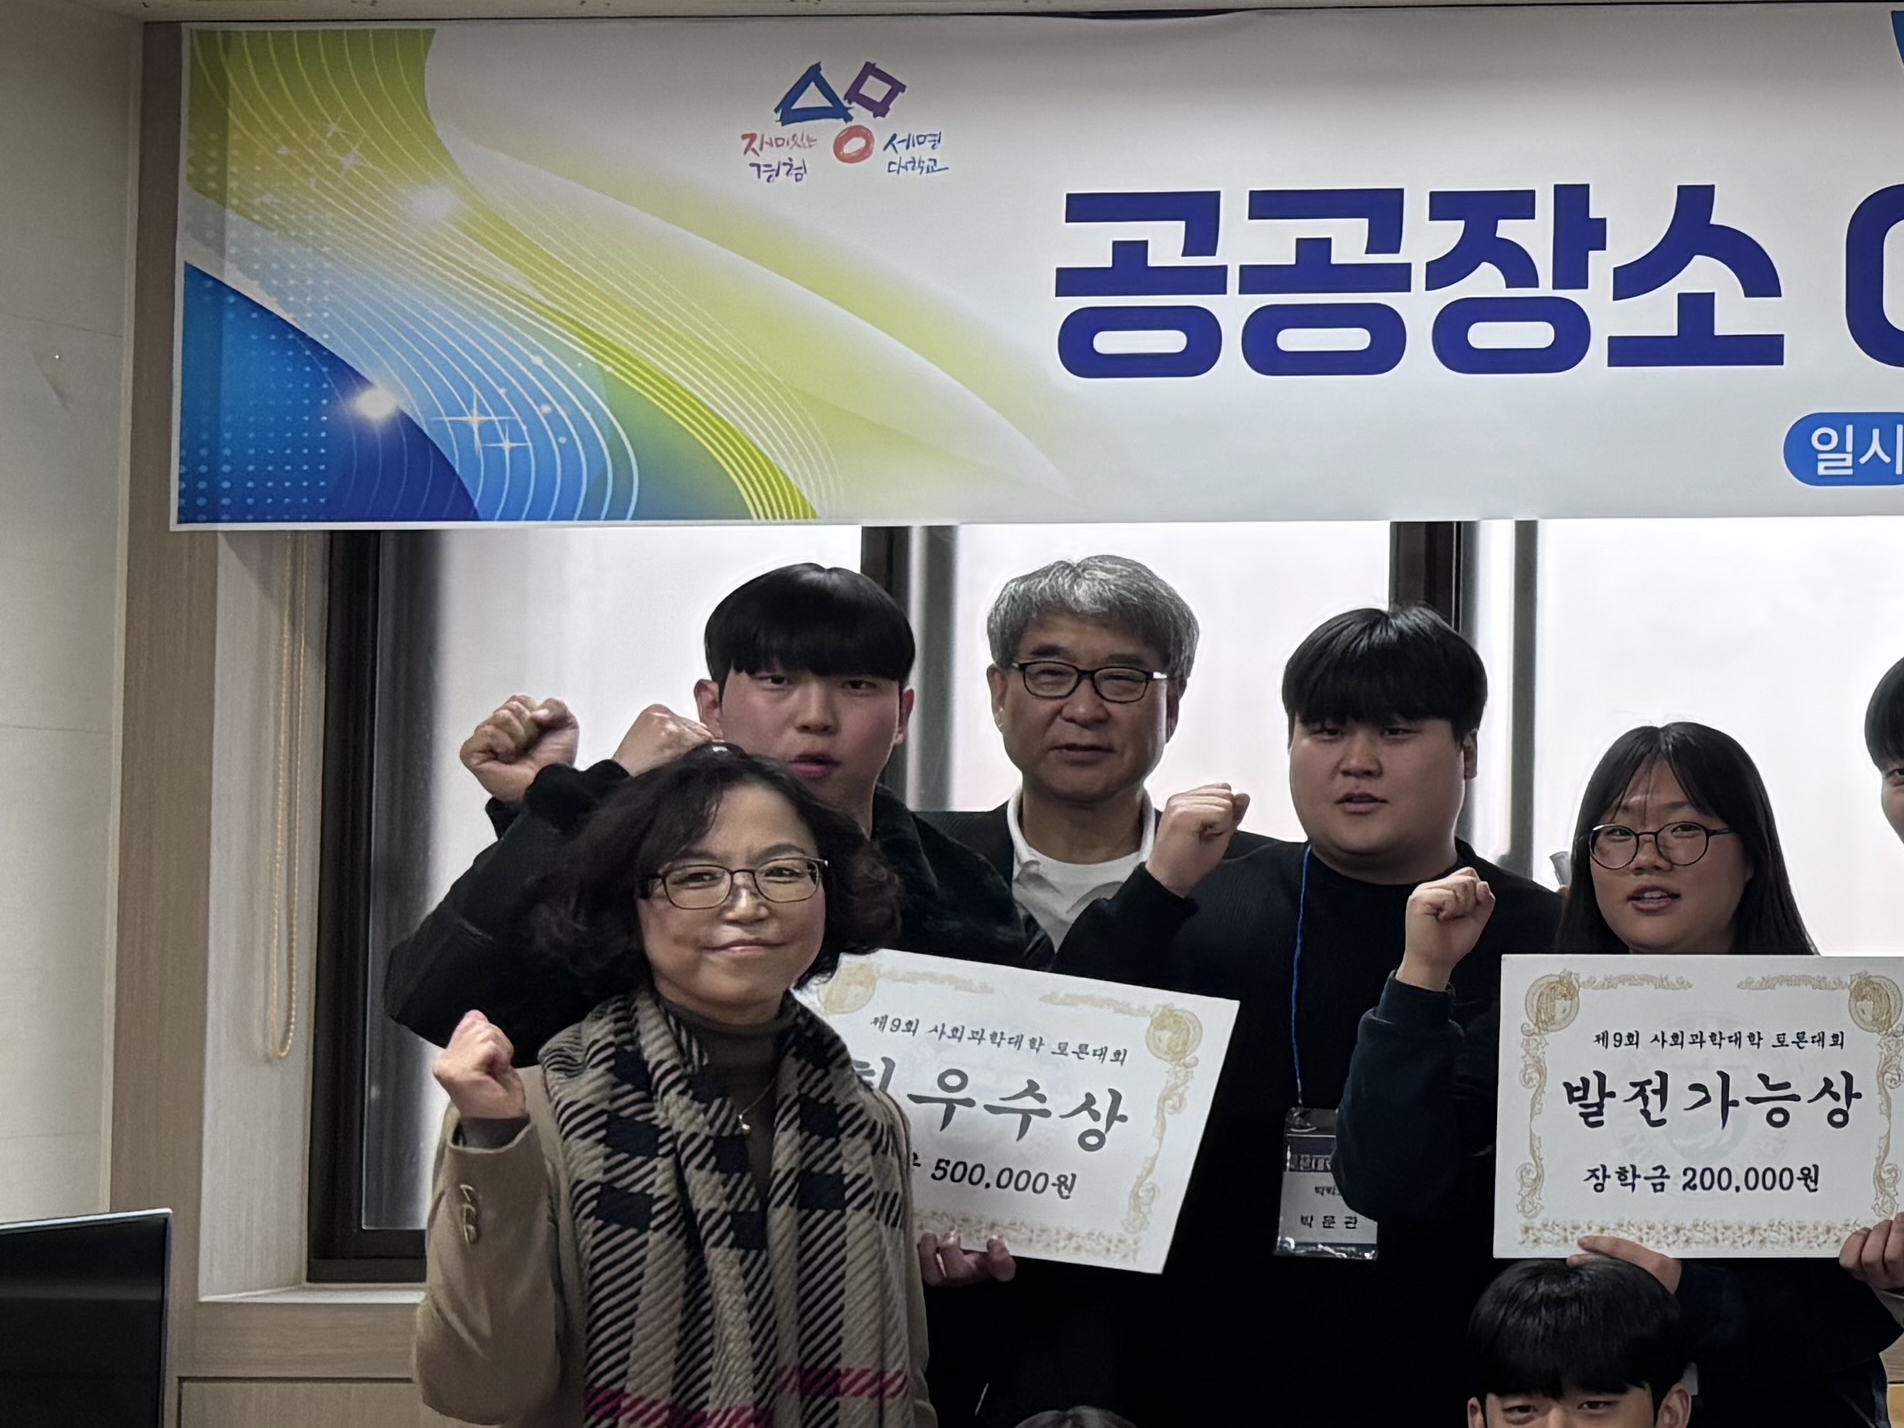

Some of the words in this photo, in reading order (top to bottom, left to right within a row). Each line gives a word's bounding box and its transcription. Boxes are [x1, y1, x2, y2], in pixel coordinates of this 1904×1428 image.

[883, 131, 942, 152] 세명
[749, 158, 808, 183] 경험
[887, 156, 949, 175] 대학교
[1055, 184, 1784, 378] 공공장소
[1812, 425, 1903, 475] 일시
[871, 1015, 919, 1036] 제9회
[929, 1023, 1045, 1053] 사회과학대학
[1051, 1042, 1127, 1066] 토론대회
[1594, 1030, 1639, 1049] 제9회
[1651, 1031, 1763, 1049] 사회과학대학
[1772, 1031, 1844, 1049] 토론대회
[1563, 1071, 1862, 1129] 발전가능상
[1584, 1164, 1670, 1193] 장학금
[1682, 1164, 1819, 1192] 200,000원
